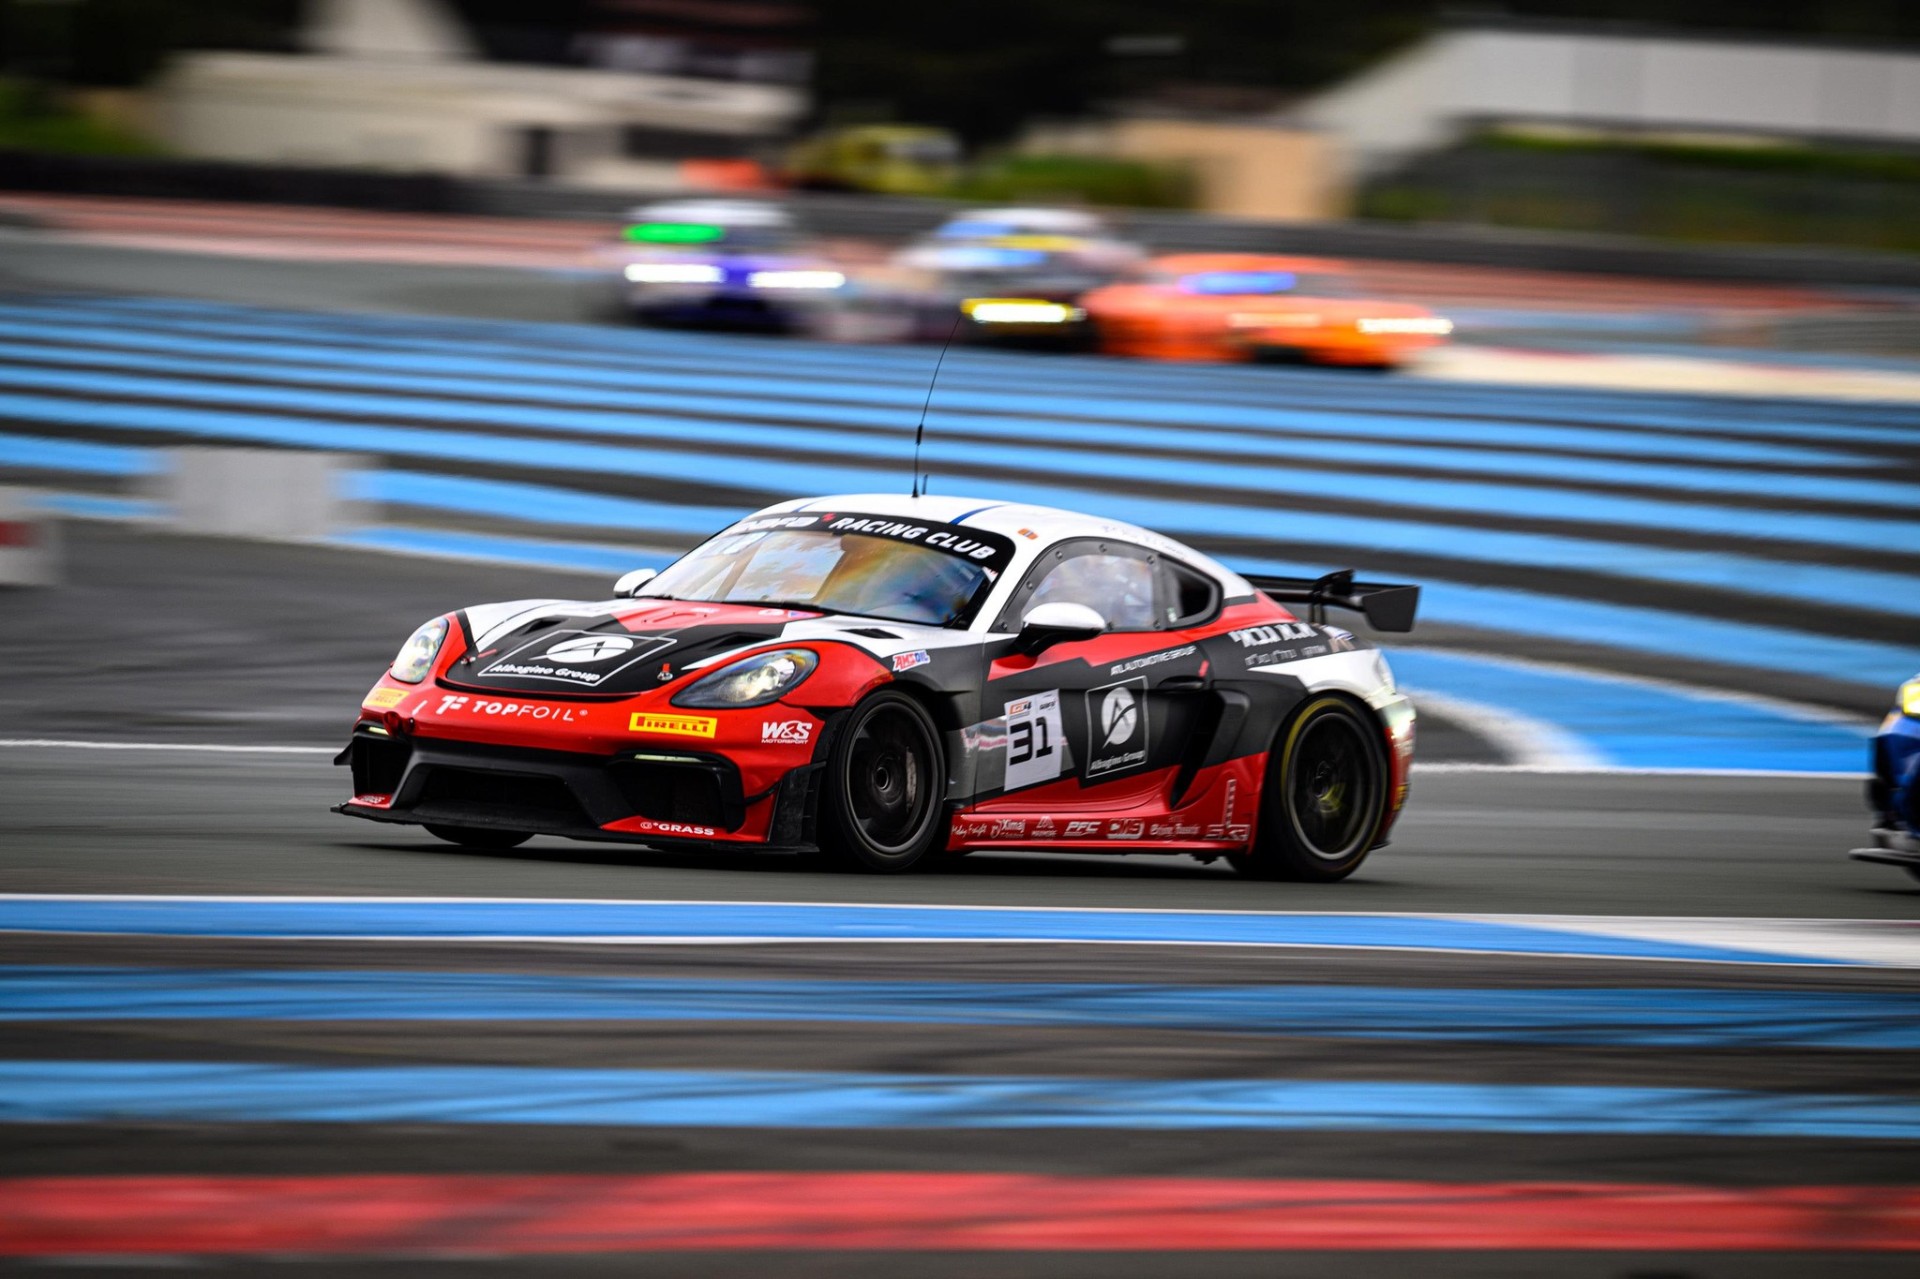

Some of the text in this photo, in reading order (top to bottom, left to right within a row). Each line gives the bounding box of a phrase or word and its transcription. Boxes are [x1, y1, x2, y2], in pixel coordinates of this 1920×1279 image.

[829, 516, 928, 539] RACING
[925, 532, 997, 560] CLUB
[555, 667, 600, 682] Group
[636, 716, 710, 733] PIRELLI
[761, 720, 813, 740] W&S
[1009, 717, 1053, 766] 31
[658, 823, 715, 836] GRASS
